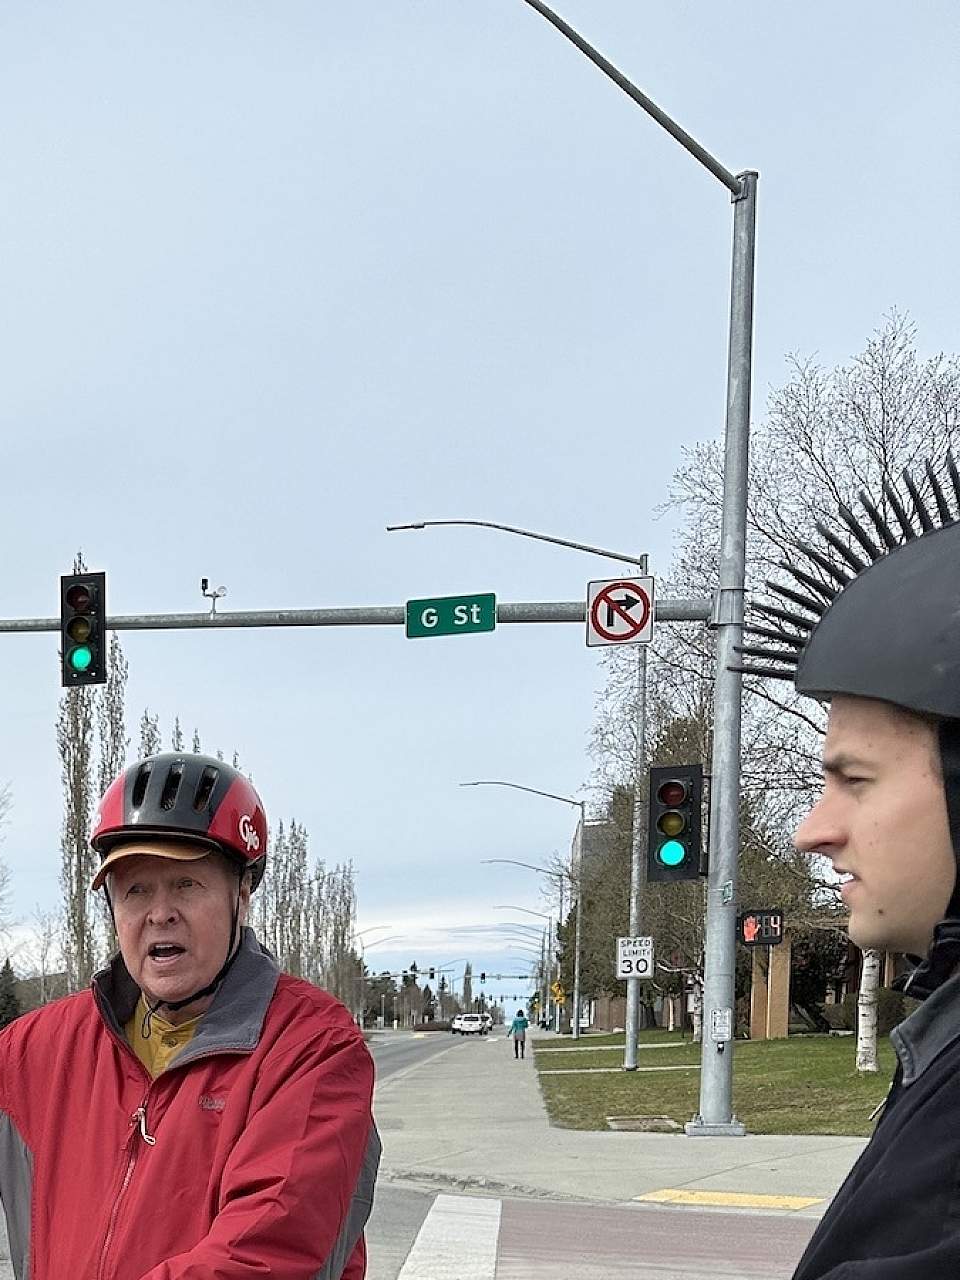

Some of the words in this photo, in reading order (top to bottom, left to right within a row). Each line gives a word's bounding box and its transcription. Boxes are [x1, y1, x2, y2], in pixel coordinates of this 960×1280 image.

[421, 608, 439, 628] G
[454, 604, 481, 625] St
[620, 939, 651, 948] SPEED
[622, 949, 651, 957] LIMIT
[622, 958, 648, 974] 30
